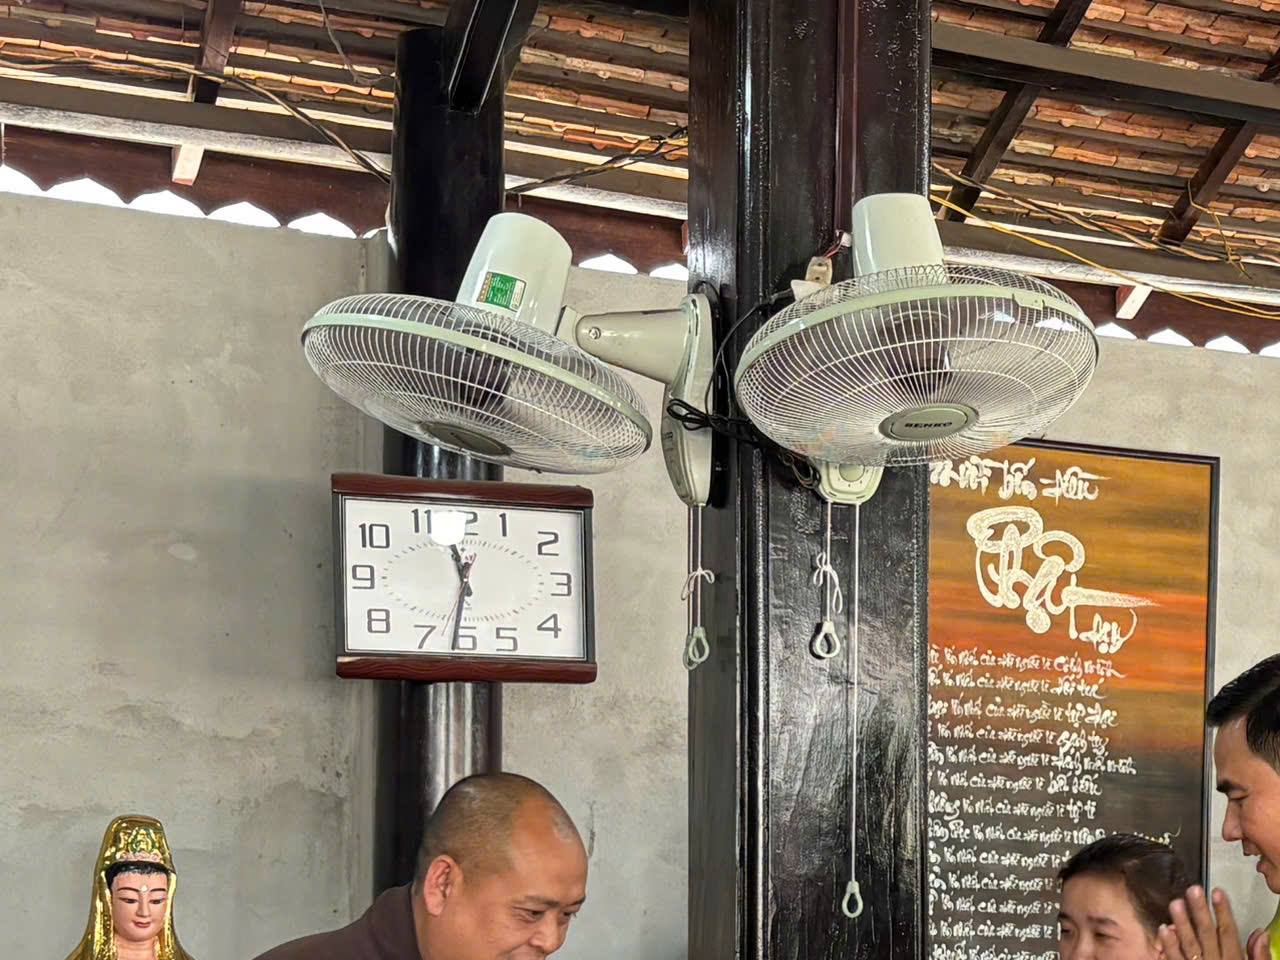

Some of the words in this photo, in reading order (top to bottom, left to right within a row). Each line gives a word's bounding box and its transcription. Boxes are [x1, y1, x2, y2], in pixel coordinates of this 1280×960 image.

[358, 523, 391, 550] 10
[499, 512, 507, 537] 1
[537, 531, 560, 556] 2
[352, 564, 376, 589] 9
[550, 572, 573, 597] 3
[367, 608, 391, 634] 8
[536, 613, 562, 639] 4
[414, 625, 437, 650] 7
[495, 627, 519, 652] 5
